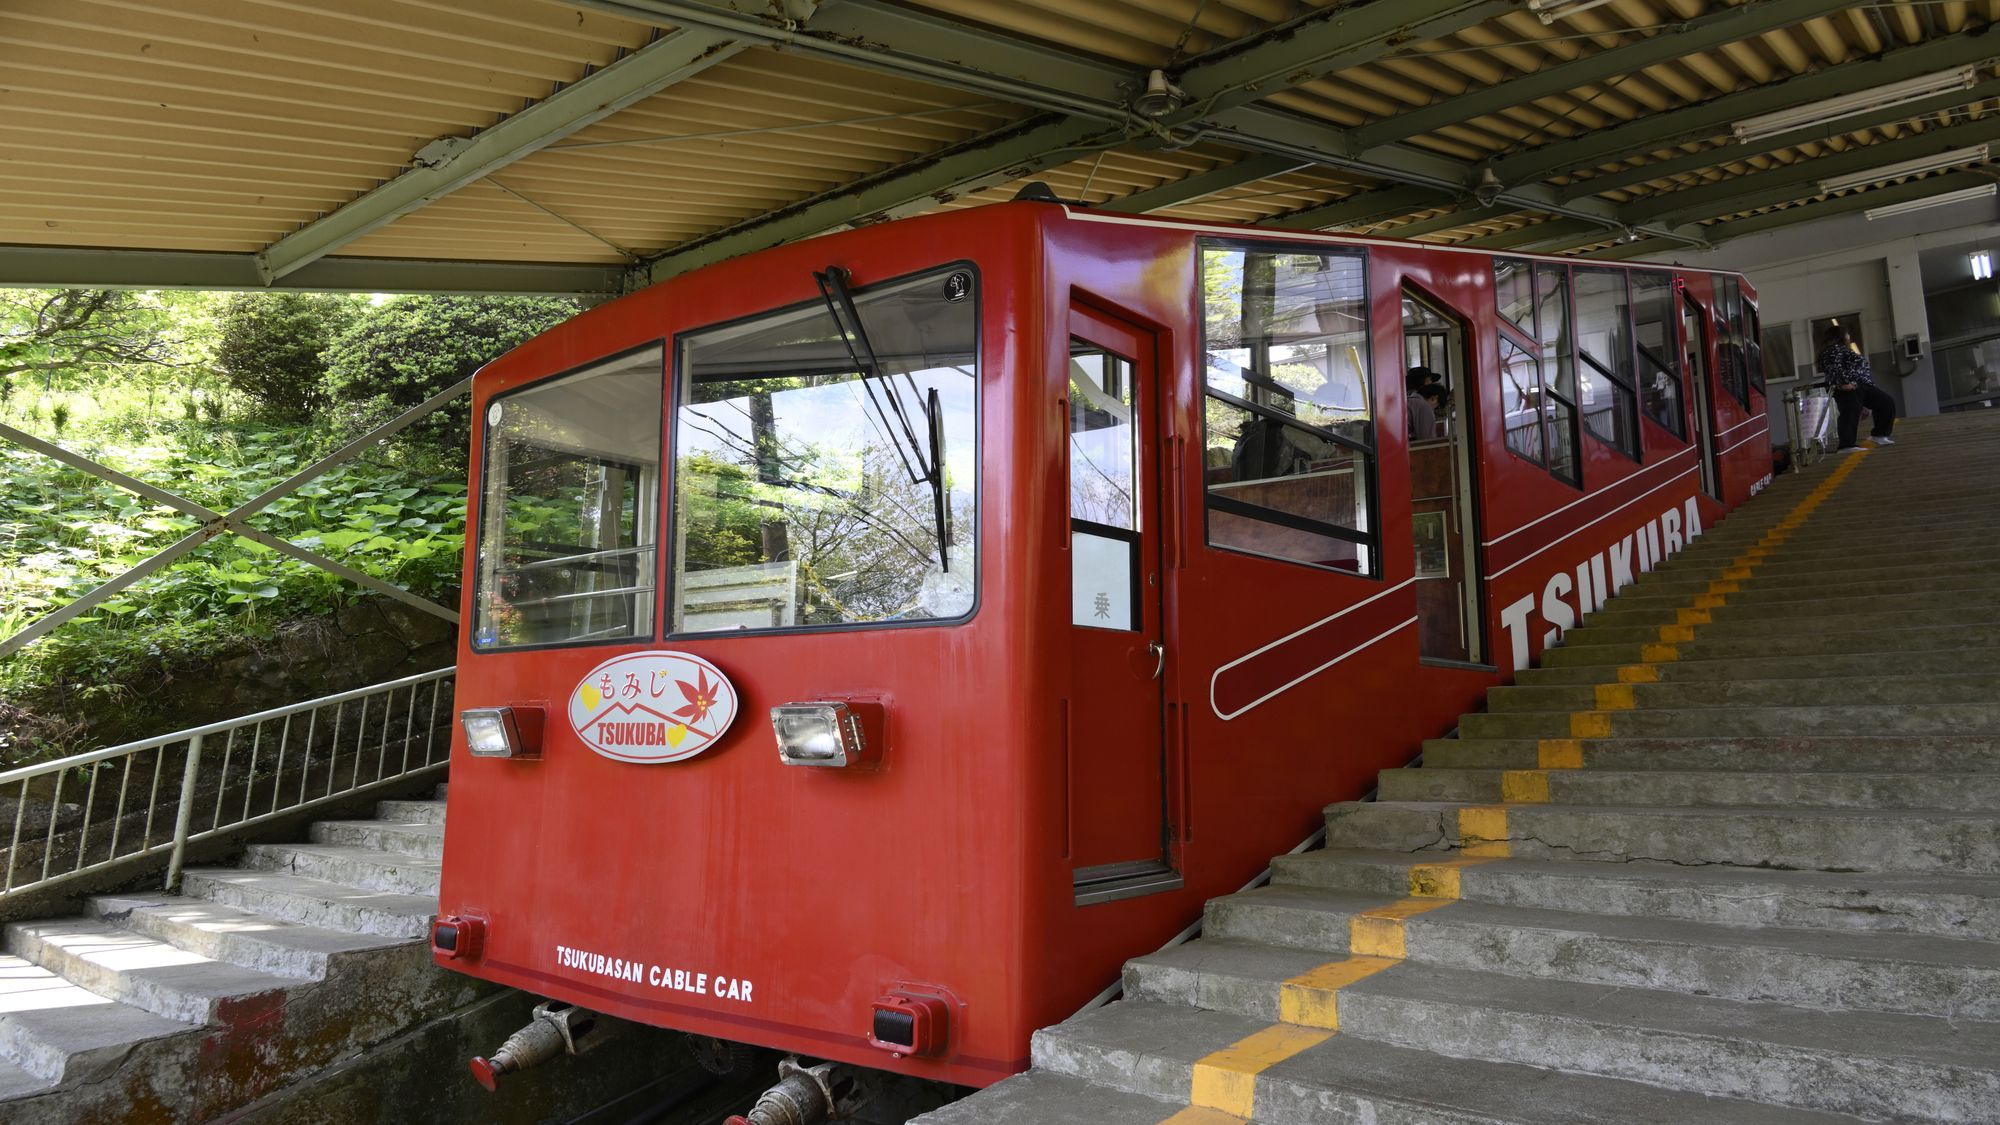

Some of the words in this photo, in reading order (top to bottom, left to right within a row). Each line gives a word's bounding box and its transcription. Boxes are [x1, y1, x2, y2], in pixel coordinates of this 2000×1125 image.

[1500, 495, 1702, 671] TSUKUBA
[1094, 592, 1110, 619] 乗
[600, 669, 668, 699] もみじ
[598, 722, 666, 746] TSUKUBA
[557, 946, 643, 983] TSUKUBASAN
[649, 965, 707, 994] CABLE
[714, 976, 753, 1002] CAR
